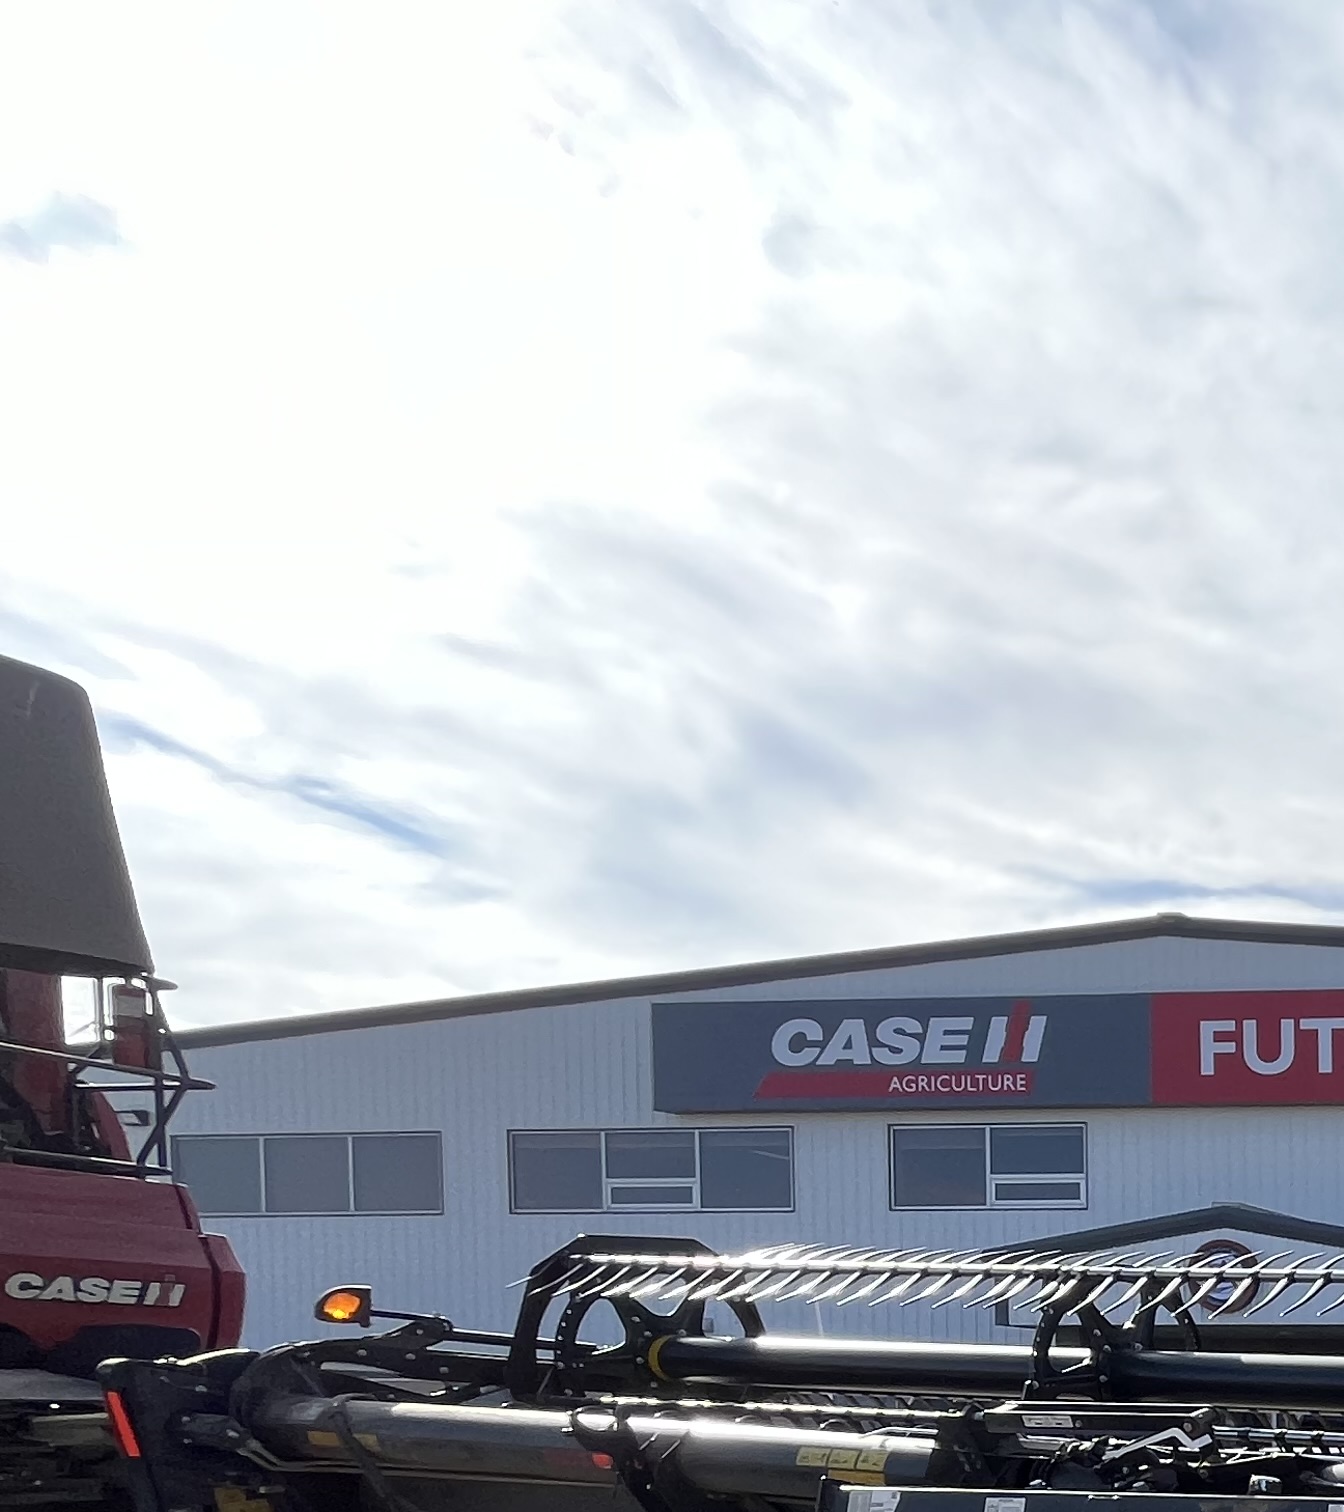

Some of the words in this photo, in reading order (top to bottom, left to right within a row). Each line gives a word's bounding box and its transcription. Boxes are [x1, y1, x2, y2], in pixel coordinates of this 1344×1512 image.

[771, 1016, 974, 1066] CASE
[888, 1073, 1028, 1092] AGRICULTURE
[5, 1272, 142, 1304] CASE
